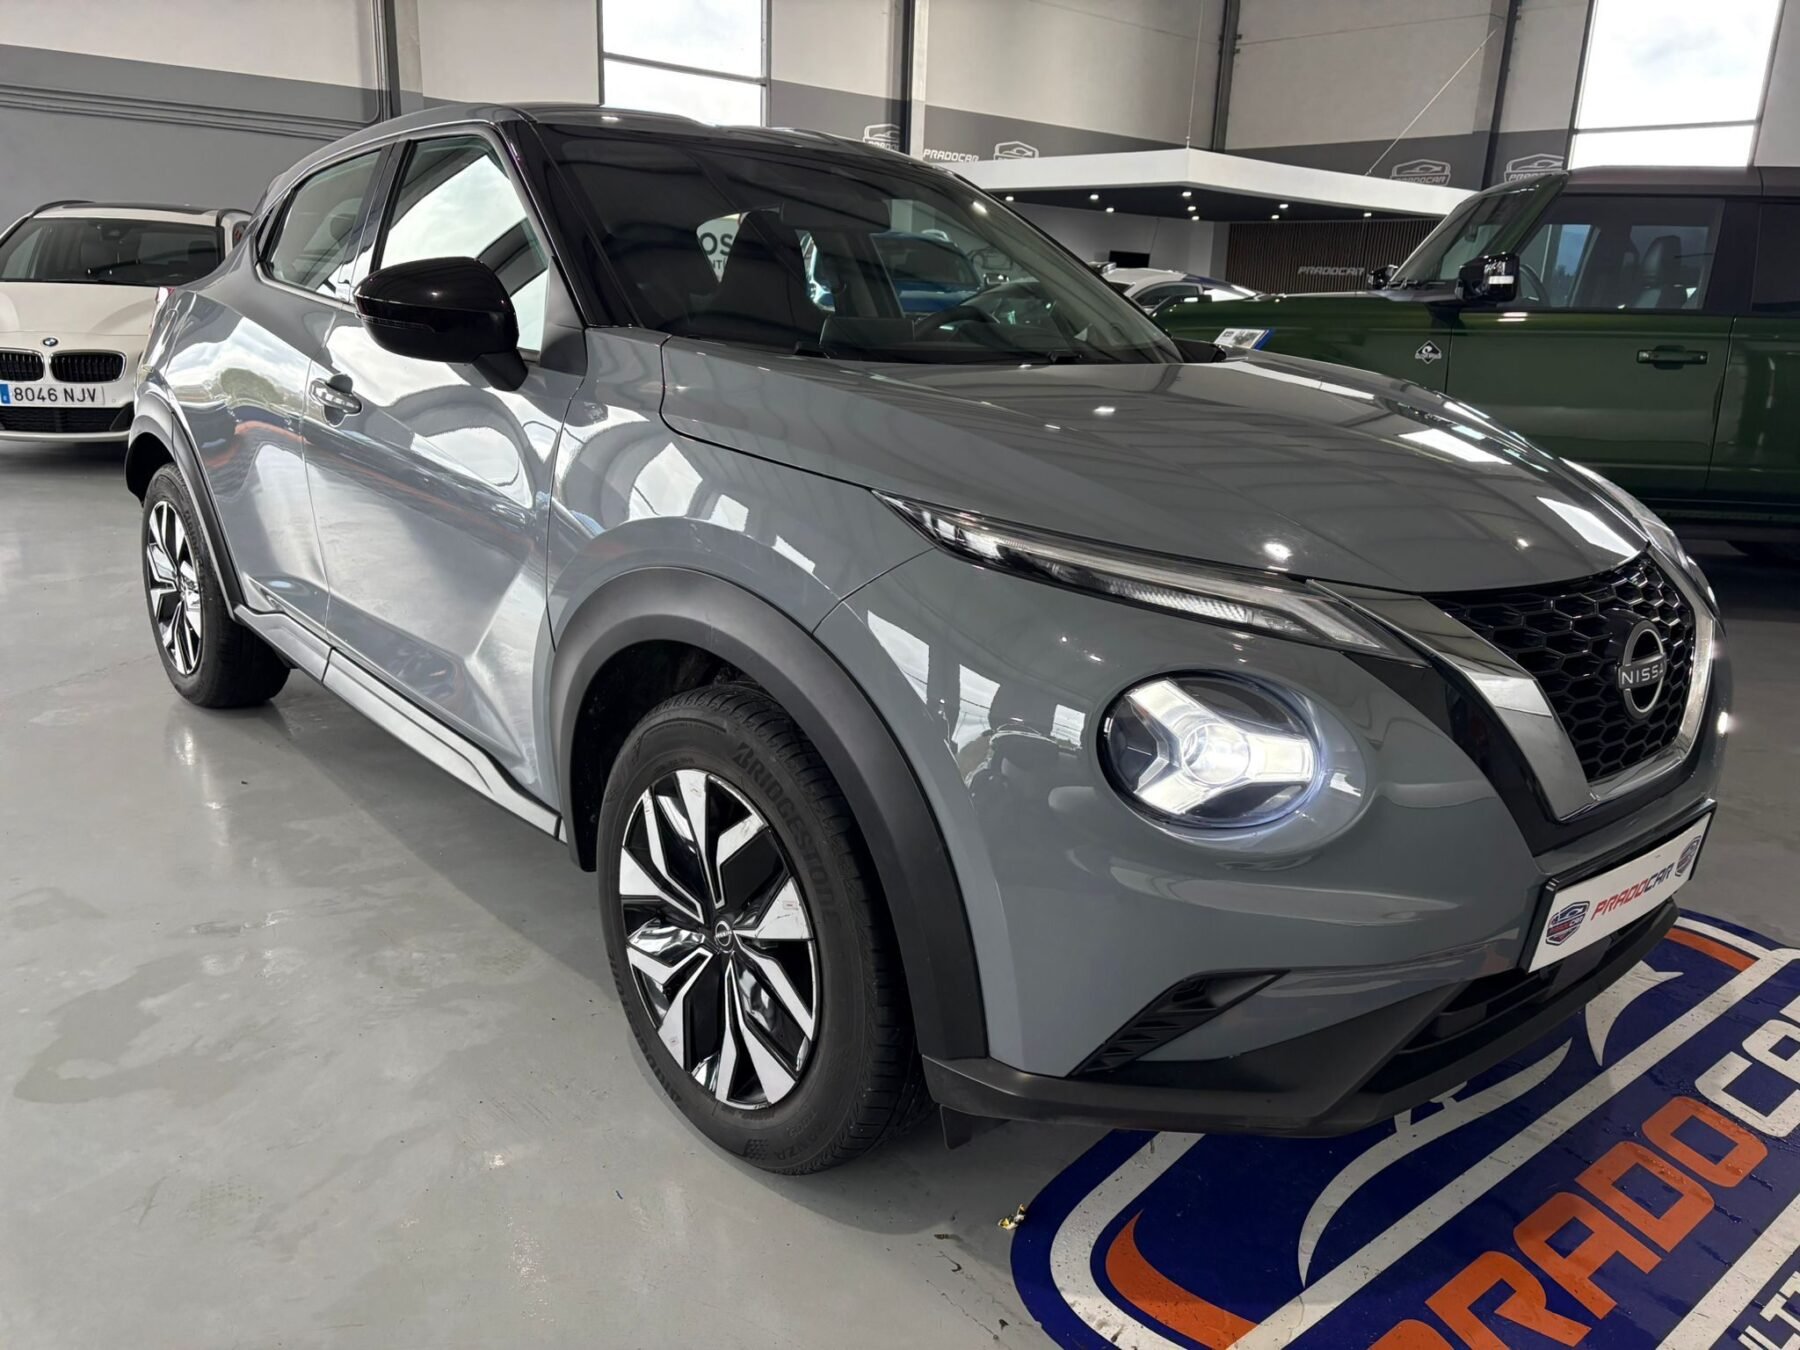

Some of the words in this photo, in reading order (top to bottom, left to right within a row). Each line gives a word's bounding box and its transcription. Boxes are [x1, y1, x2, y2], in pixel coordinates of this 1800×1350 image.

[923, 148, 979, 163] PRADOCAR
[14, 387, 58, 402] 8046
[63, 388, 96, 402] NJV
[1621, 662, 1664, 685] NISS
[1590, 862, 1675, 921] PRADOCAR
